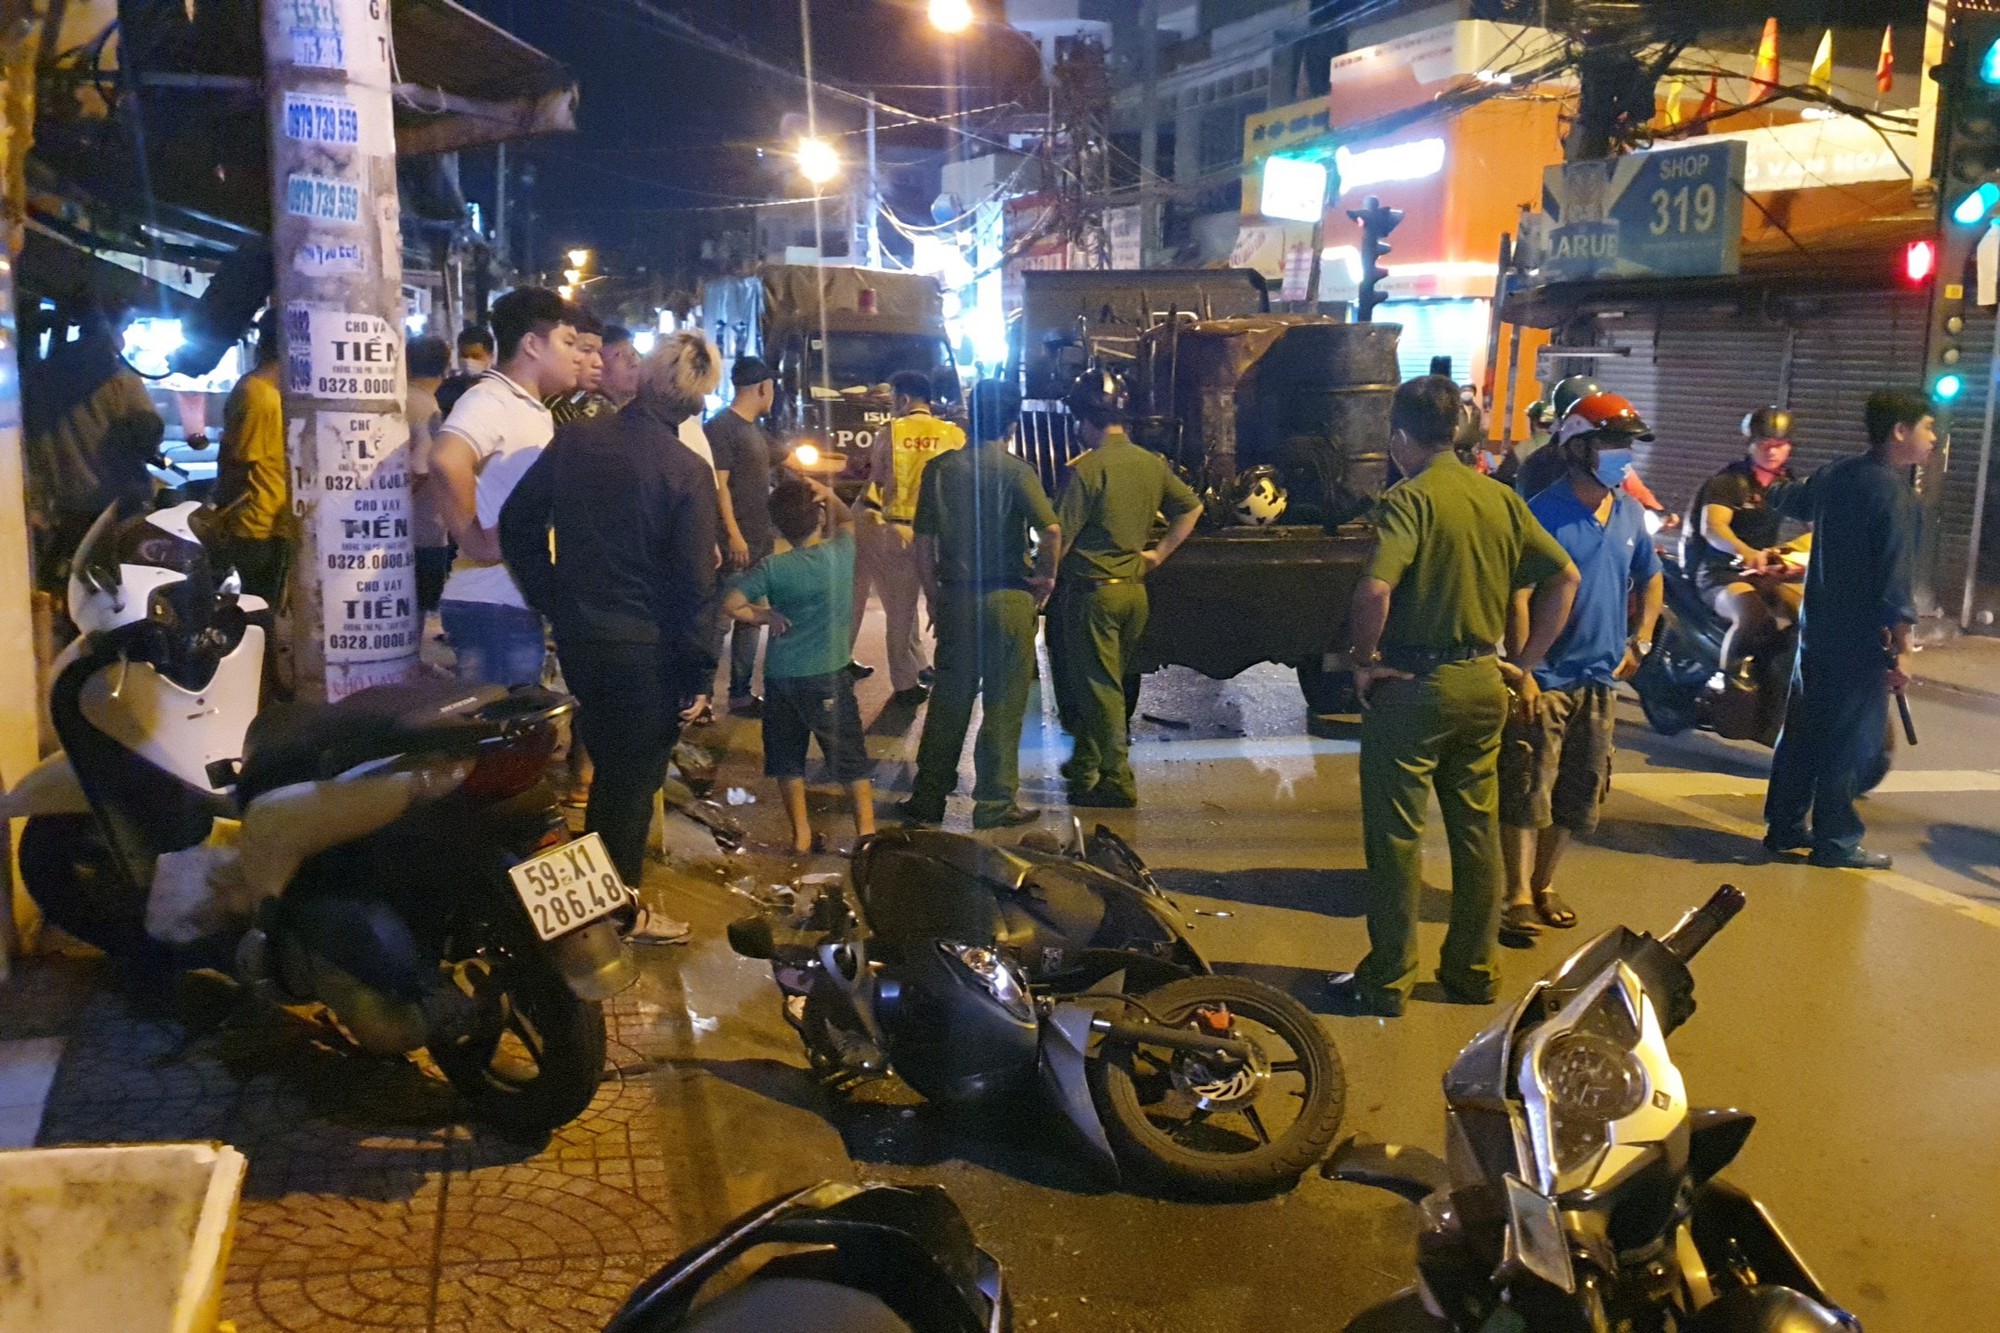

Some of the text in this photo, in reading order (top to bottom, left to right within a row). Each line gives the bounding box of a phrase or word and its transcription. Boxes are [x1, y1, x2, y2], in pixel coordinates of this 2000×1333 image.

[1659, 154, 1710, 180] SHOP
[1649, 183, 1717, 236] 319
[345, 320, 387, 333] CHO VA
[355, 500, 377, 512] CHO
[357, 581, 379, 593] CHO
[342, 593, 410, 619] TIỀN
[524, 844, 596, 896] 59-X1
[533, 873, 621, 935] 286.48
